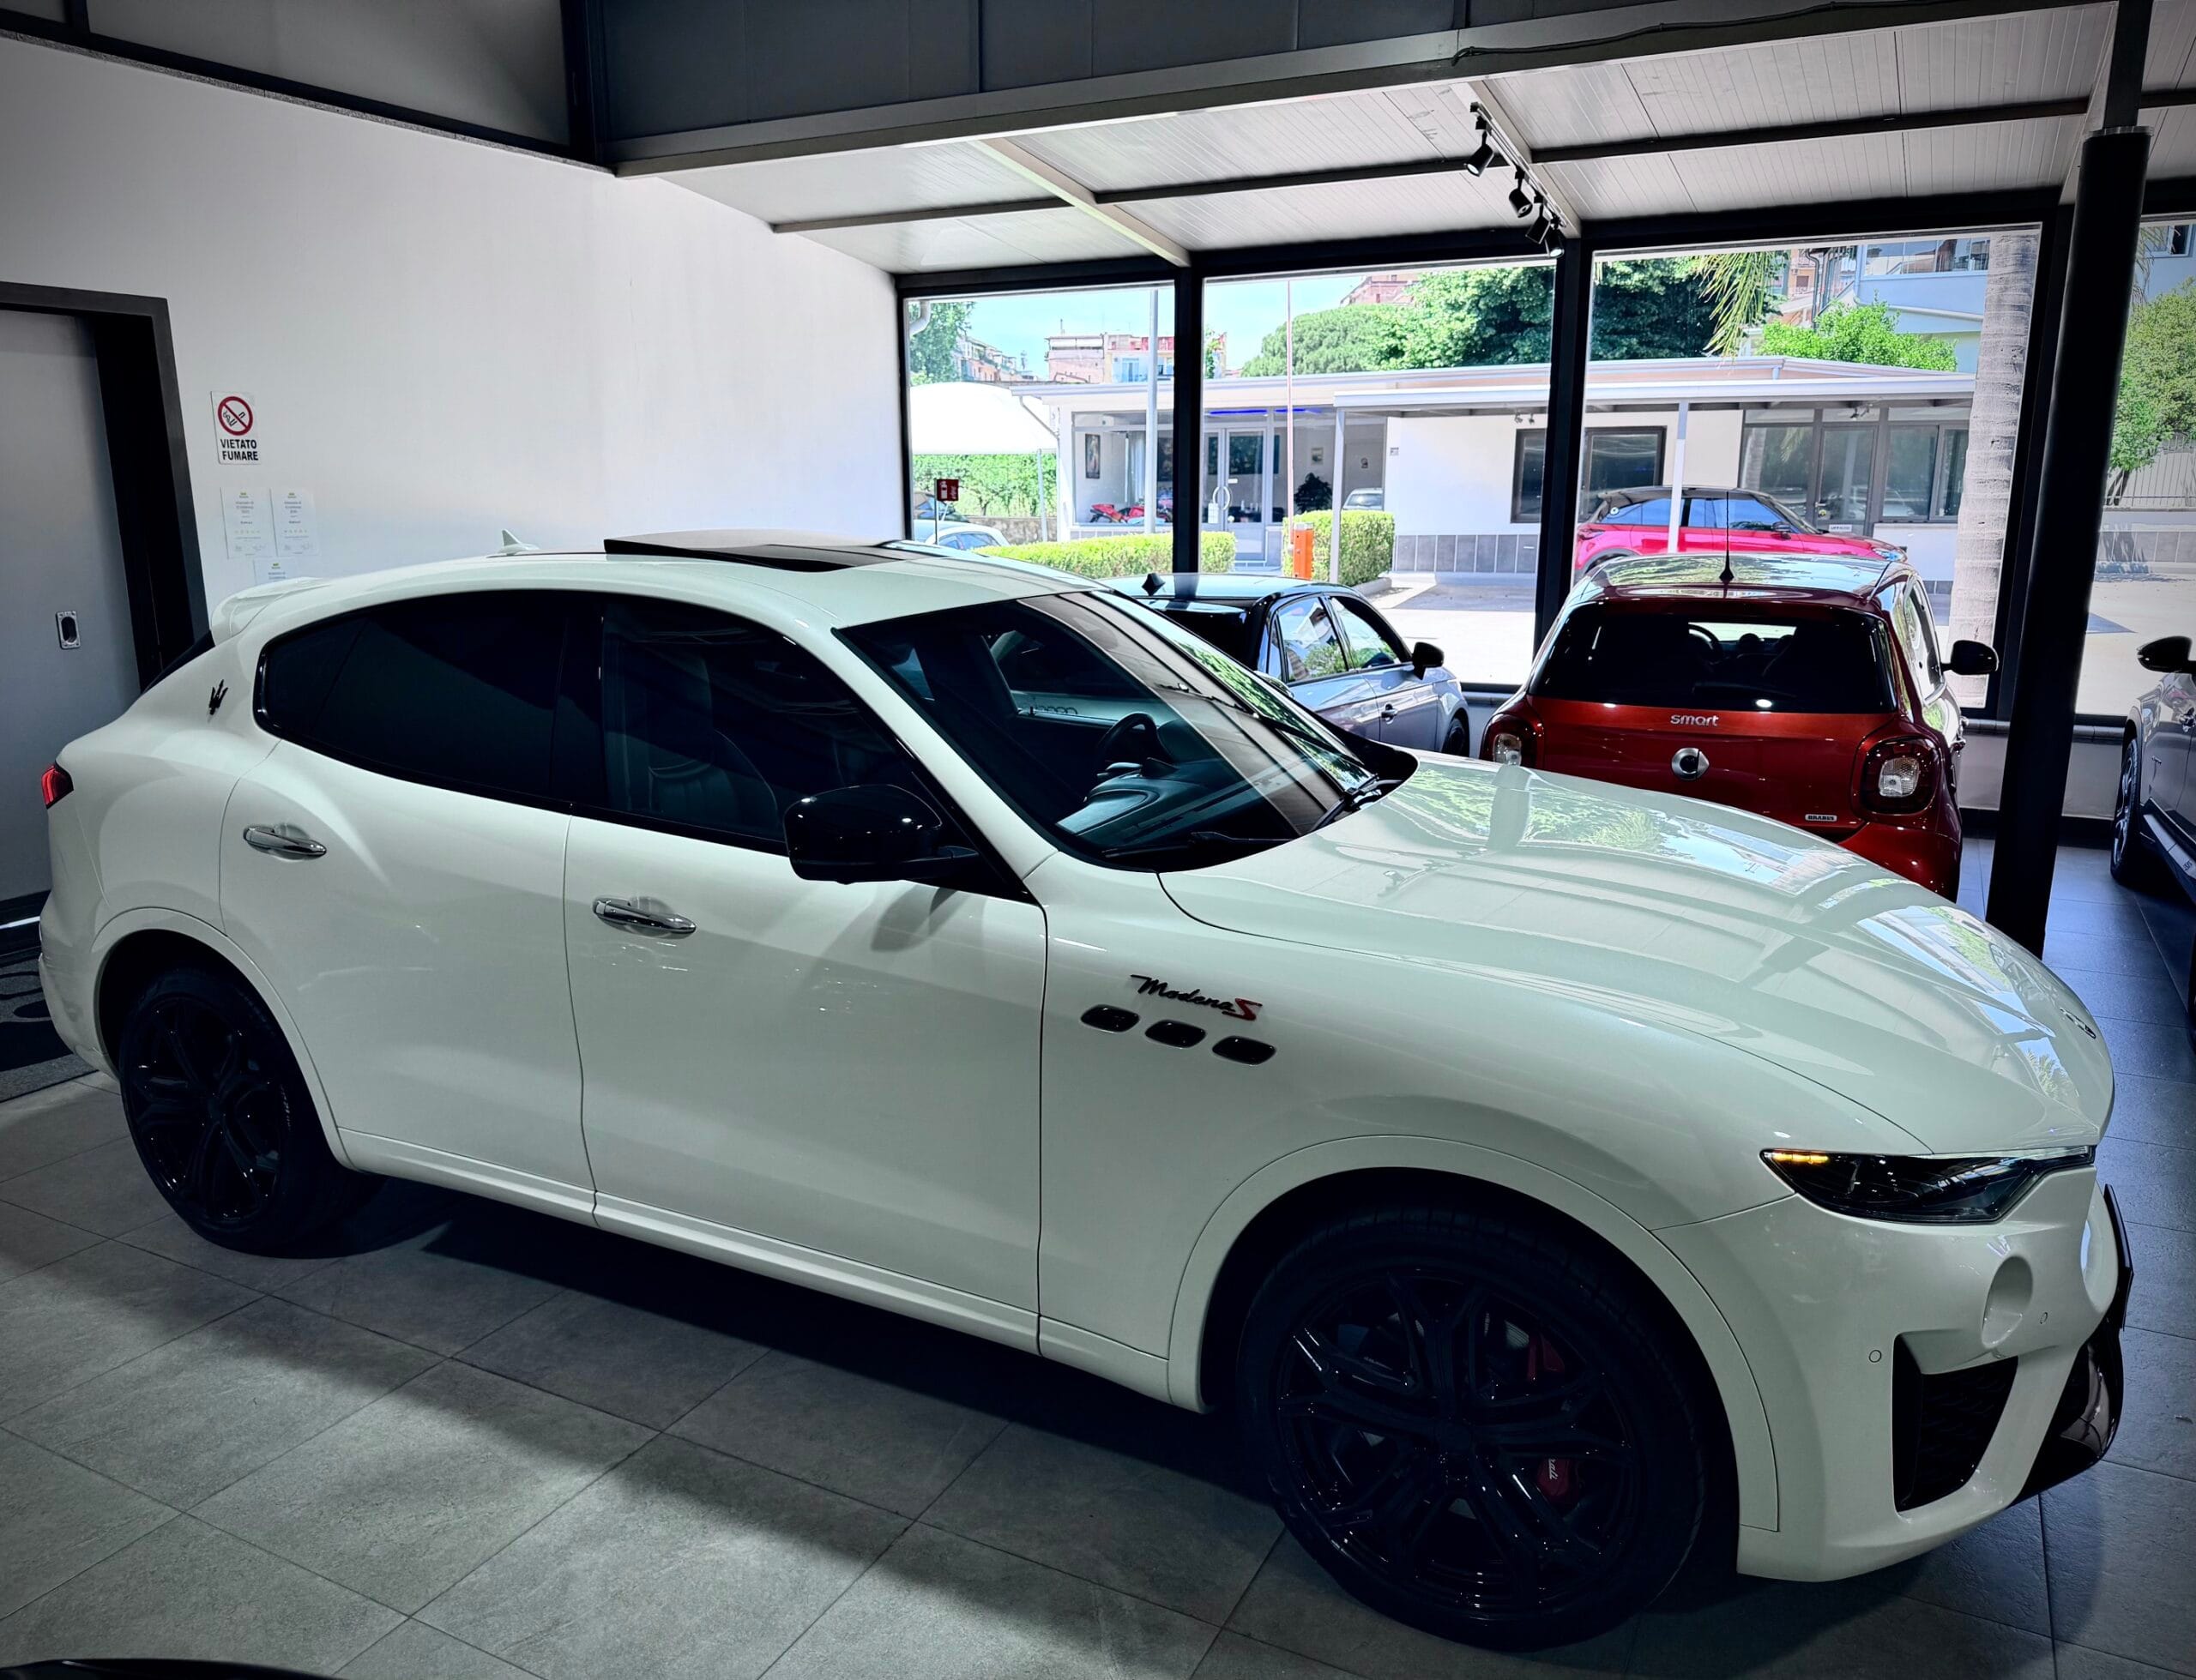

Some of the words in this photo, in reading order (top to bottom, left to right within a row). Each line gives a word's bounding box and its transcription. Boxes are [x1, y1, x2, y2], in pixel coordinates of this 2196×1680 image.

[220, 438, 257, 449] VIETATO
[221, 450, 259, 461] FUMARE
[1669, 714, 1719, 727] smart
[1130, 974, 1236, 1013] Modena
[1222, 997, 1264, 1021] S
